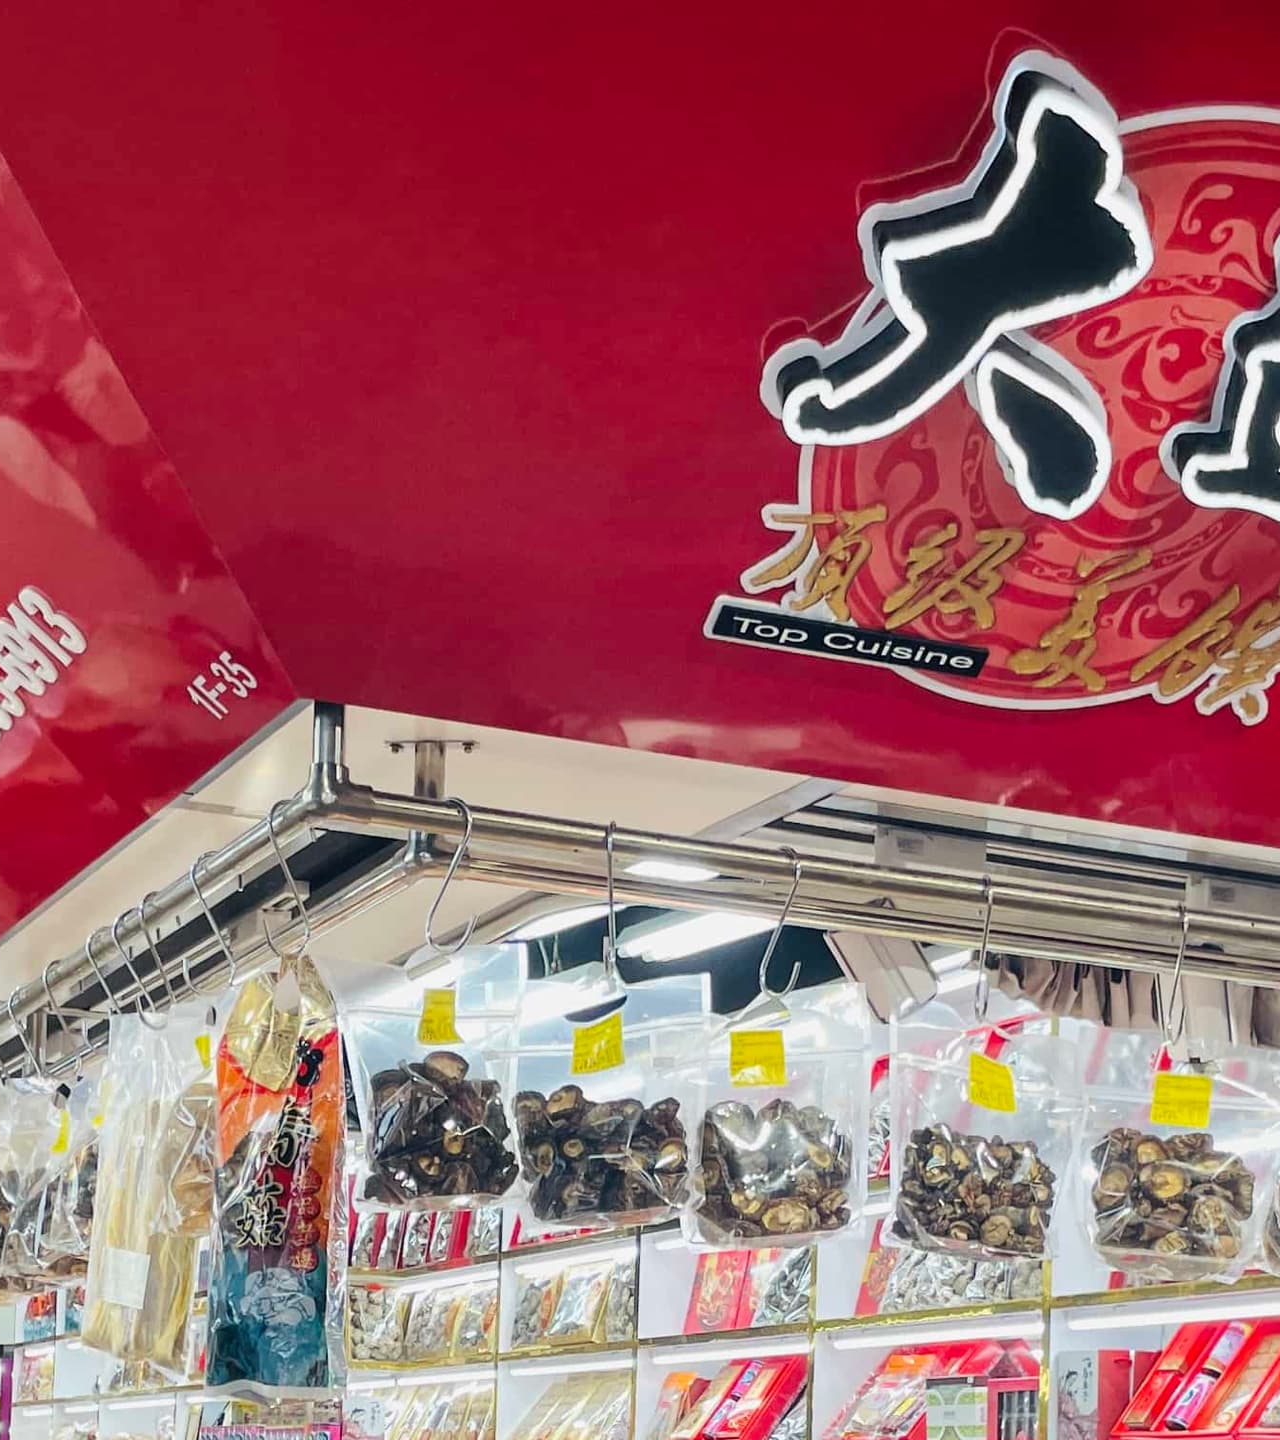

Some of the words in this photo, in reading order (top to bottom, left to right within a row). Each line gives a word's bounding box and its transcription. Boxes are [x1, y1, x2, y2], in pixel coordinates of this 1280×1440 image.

[732, 615, 809, 651] Top
[821, 628, 976, 673] Cuisine
[186, 650, 258, 720] 1F-35
